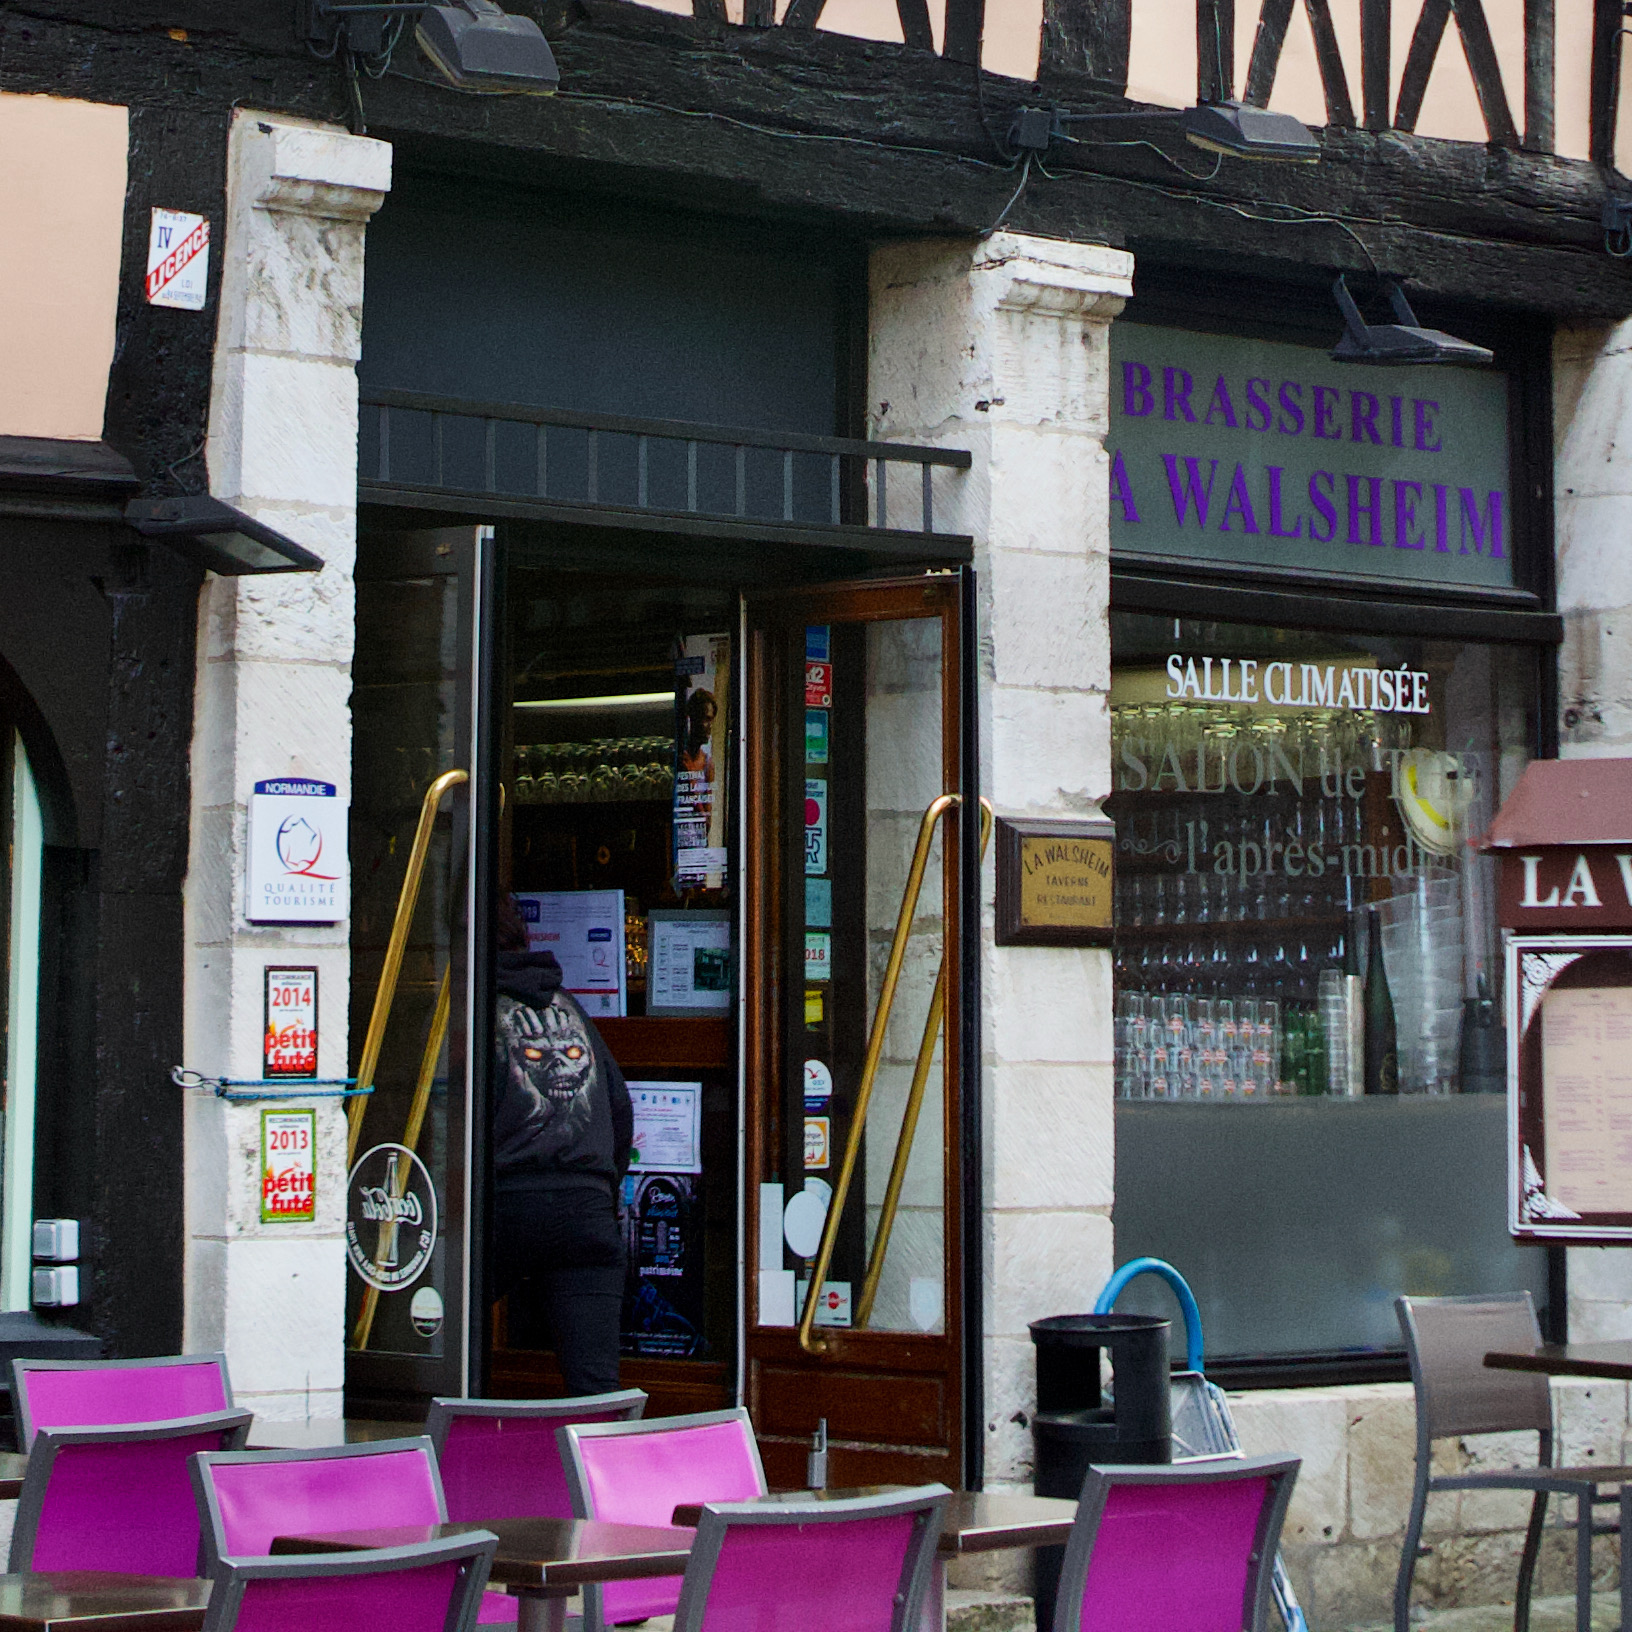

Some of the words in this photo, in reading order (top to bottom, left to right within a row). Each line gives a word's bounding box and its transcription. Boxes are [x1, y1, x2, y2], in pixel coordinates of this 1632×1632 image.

[157, 226, 174, 249] IV
[148, 220, 210, 299] LICENCE
[1120, 361, 1443, 453] BRASSERIE
[1110, 448, 1141, 523] A
[1159, 453, 1508, 559] WALSHEIM
[1166, 653, 1259, 704] SALLE
[1264, 661, 1432, 715] CLIMATISÉE
[1119, 739, 1306, 799] SALON
[1320, 745, 1366, 799] de
[265, 782, 327, 796] NORMANDIE
[1045, 844, 1110, 878] WALSHEIM
[264, 883, 335, 895] QUALITÉ
[1520, 855, 1603, 908] LA
[264, 896, 335, 906] TOURISME
[805, 948, 825, 960] 018
[272, 987, 311, 1006] 2014
[265, 1028, 317, 1055] petit
[273, 1049, 316, 1071] futé
[270, 1130, 308, 1150] 2013
[263, 1172, 315, 1198] petit
[272, 1193, 314, 1214] futé
